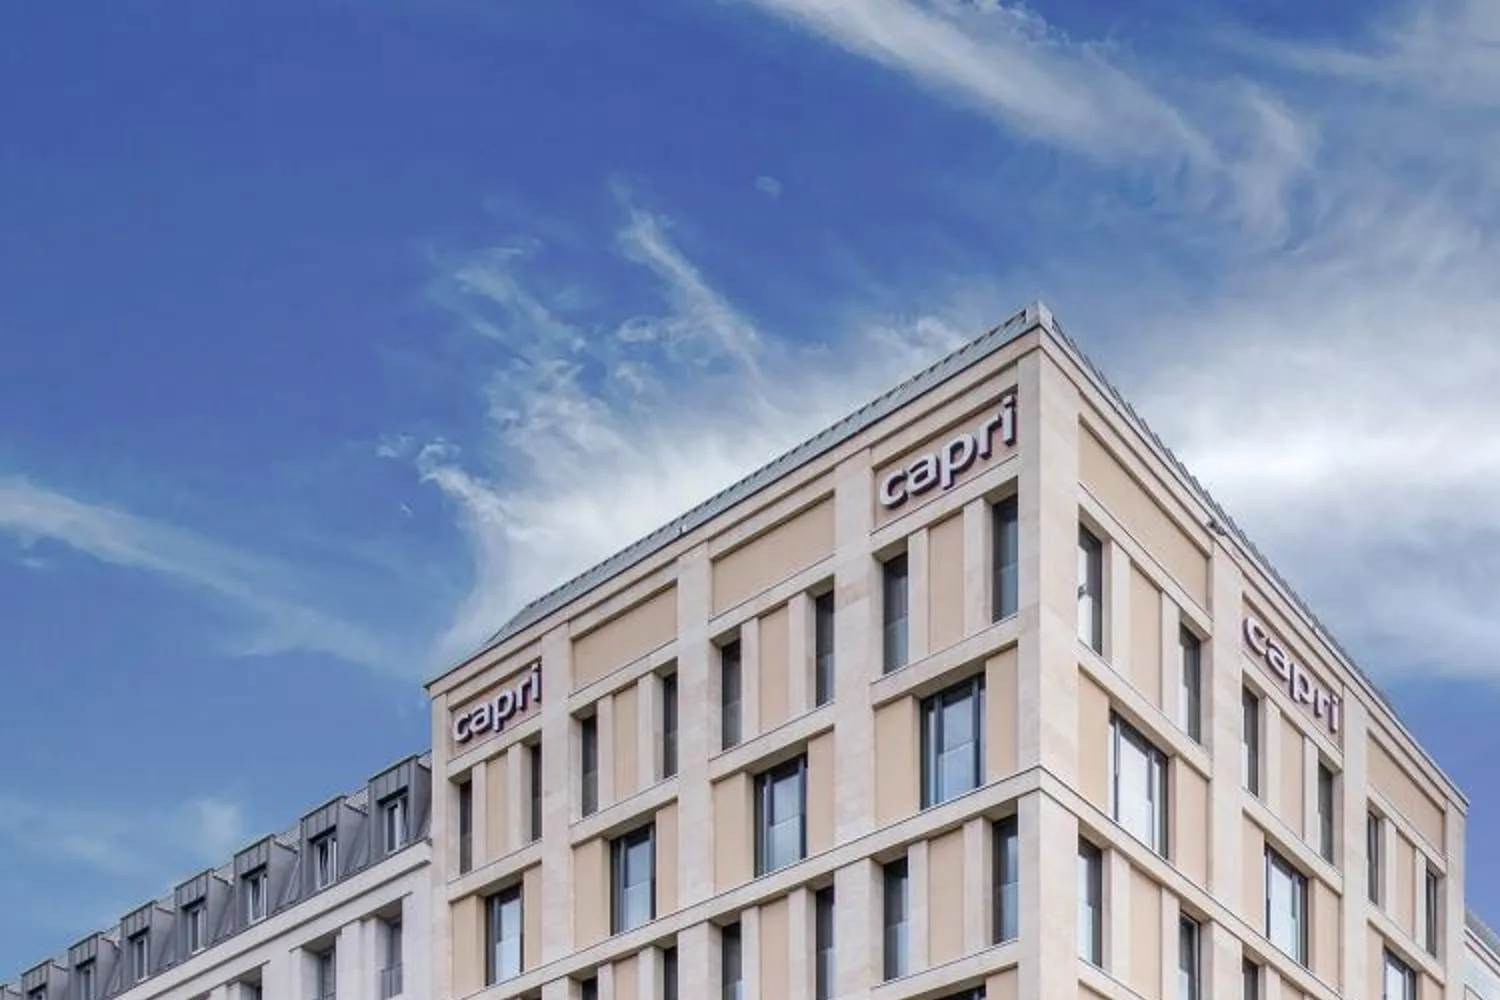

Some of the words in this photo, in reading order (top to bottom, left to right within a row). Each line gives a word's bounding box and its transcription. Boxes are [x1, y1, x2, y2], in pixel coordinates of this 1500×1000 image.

[879, 394, 1018, 511] capri
[453, 661, 542, 744] capri
[1243, 616, 1340, 735] capri
